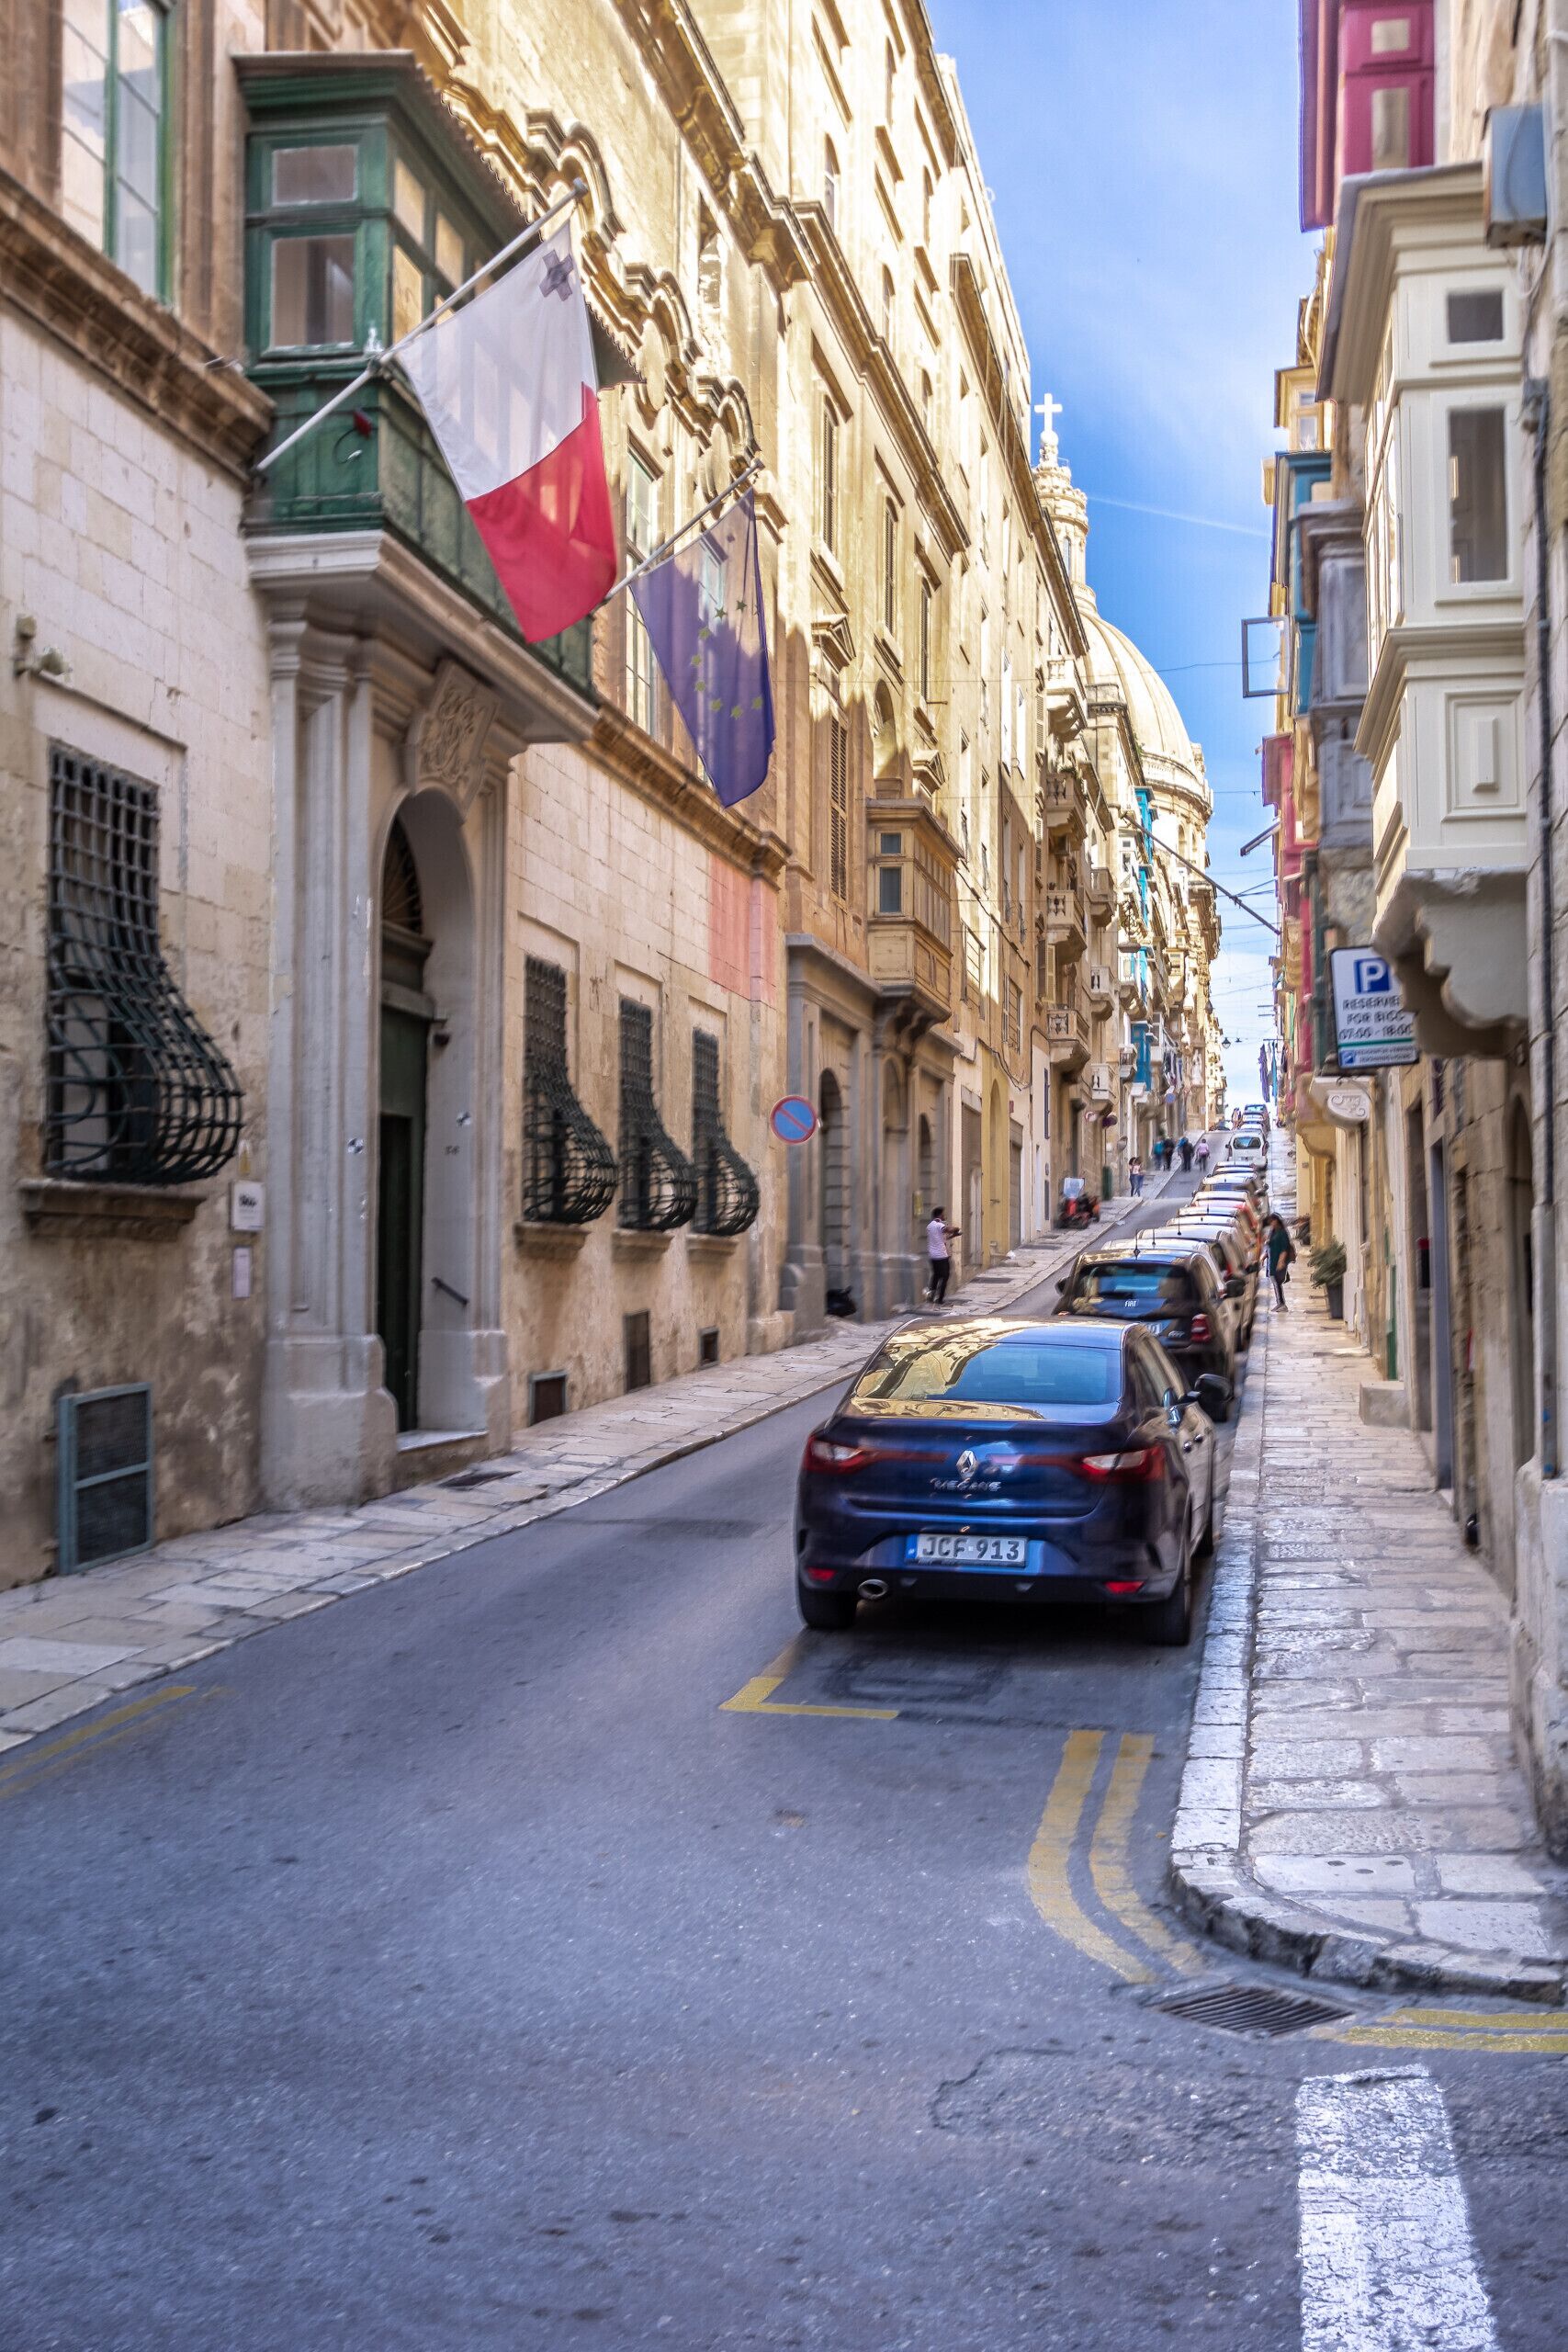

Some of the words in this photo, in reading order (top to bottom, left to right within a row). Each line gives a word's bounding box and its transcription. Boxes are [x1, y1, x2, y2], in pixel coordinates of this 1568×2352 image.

[1359, 961, 1385, 991] P
[1342, 995, 1400, 1010] RESERVE
[1347, 1012, 1371, 1024] FOR
[922, 1536, 968, 1557] JCF
[976, 1538, 1020, 1560] 913
